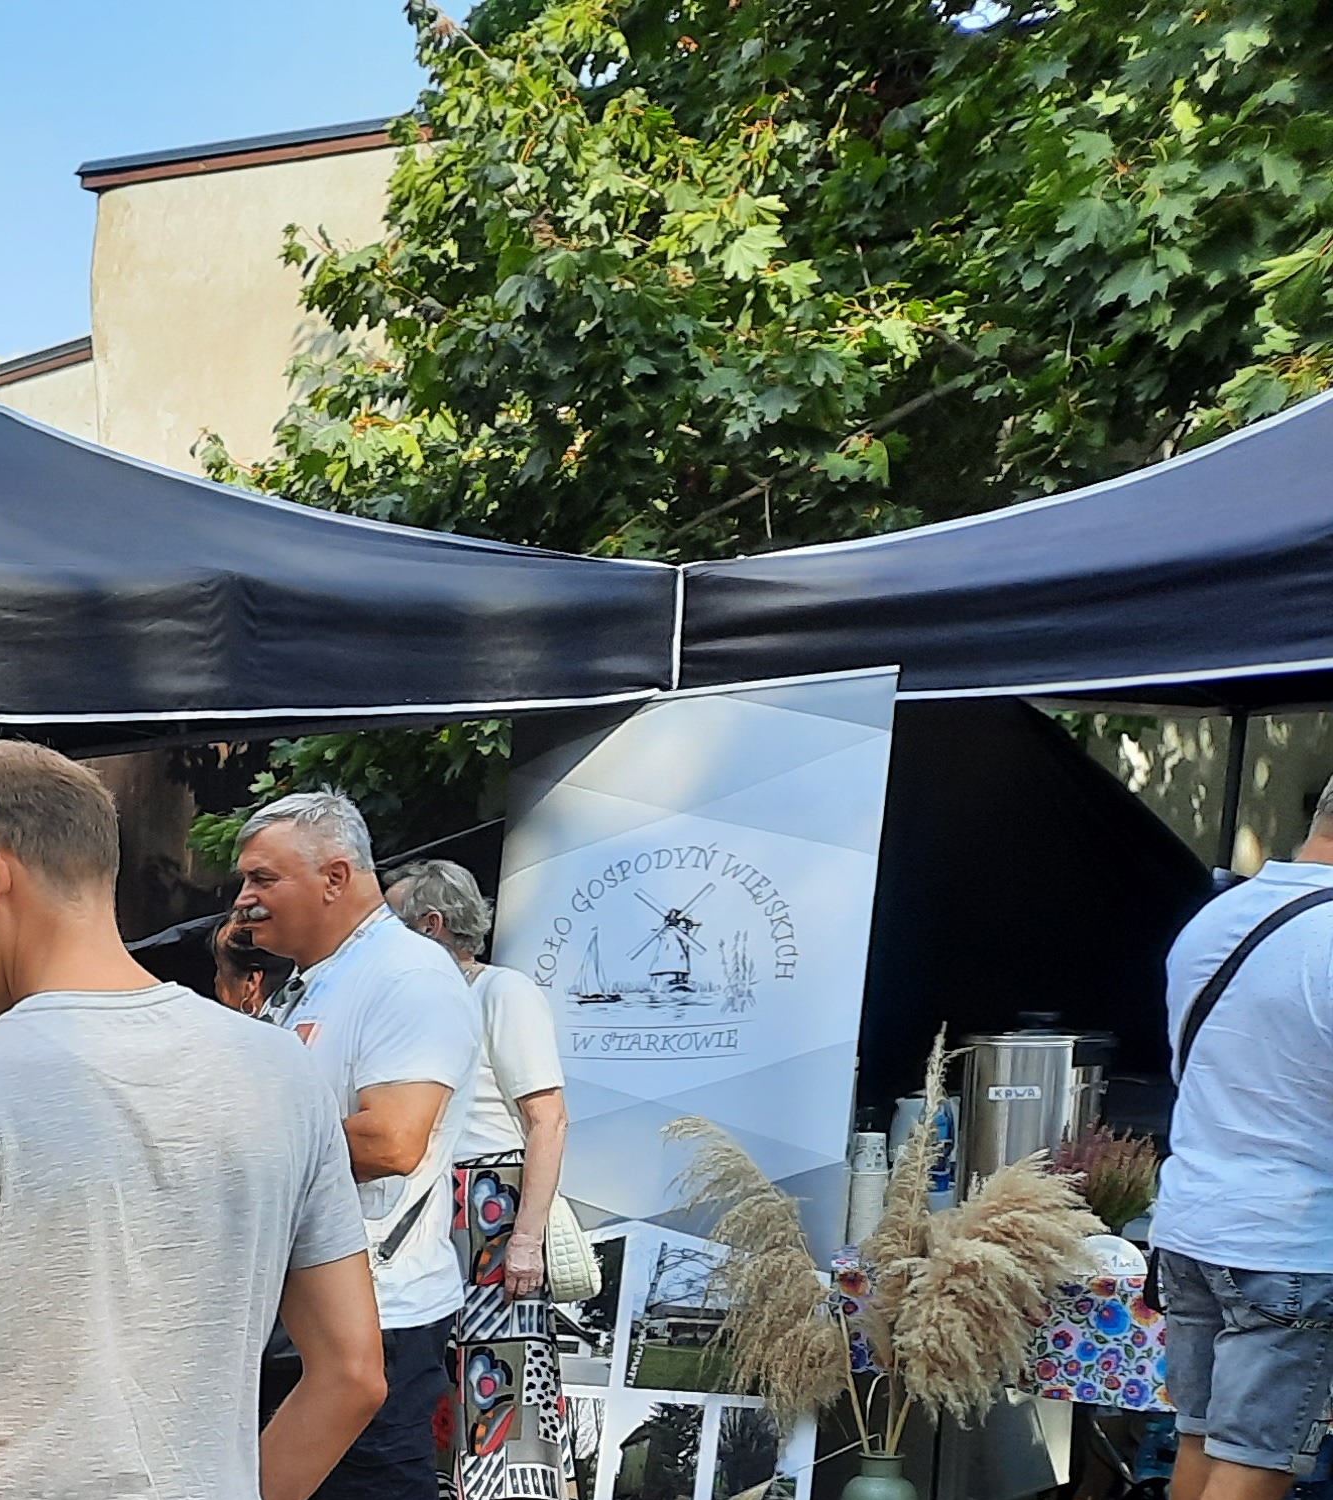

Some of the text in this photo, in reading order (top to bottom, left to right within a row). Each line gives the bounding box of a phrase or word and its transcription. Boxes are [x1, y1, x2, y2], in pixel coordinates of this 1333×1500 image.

[534, 842, 799, 989] KOŁO GOSPODYŃ WIEJSKICH
[571, 1029, 739, 1053] W STARKOWIE
[994, 1088, 1036, 1099] KAWA
